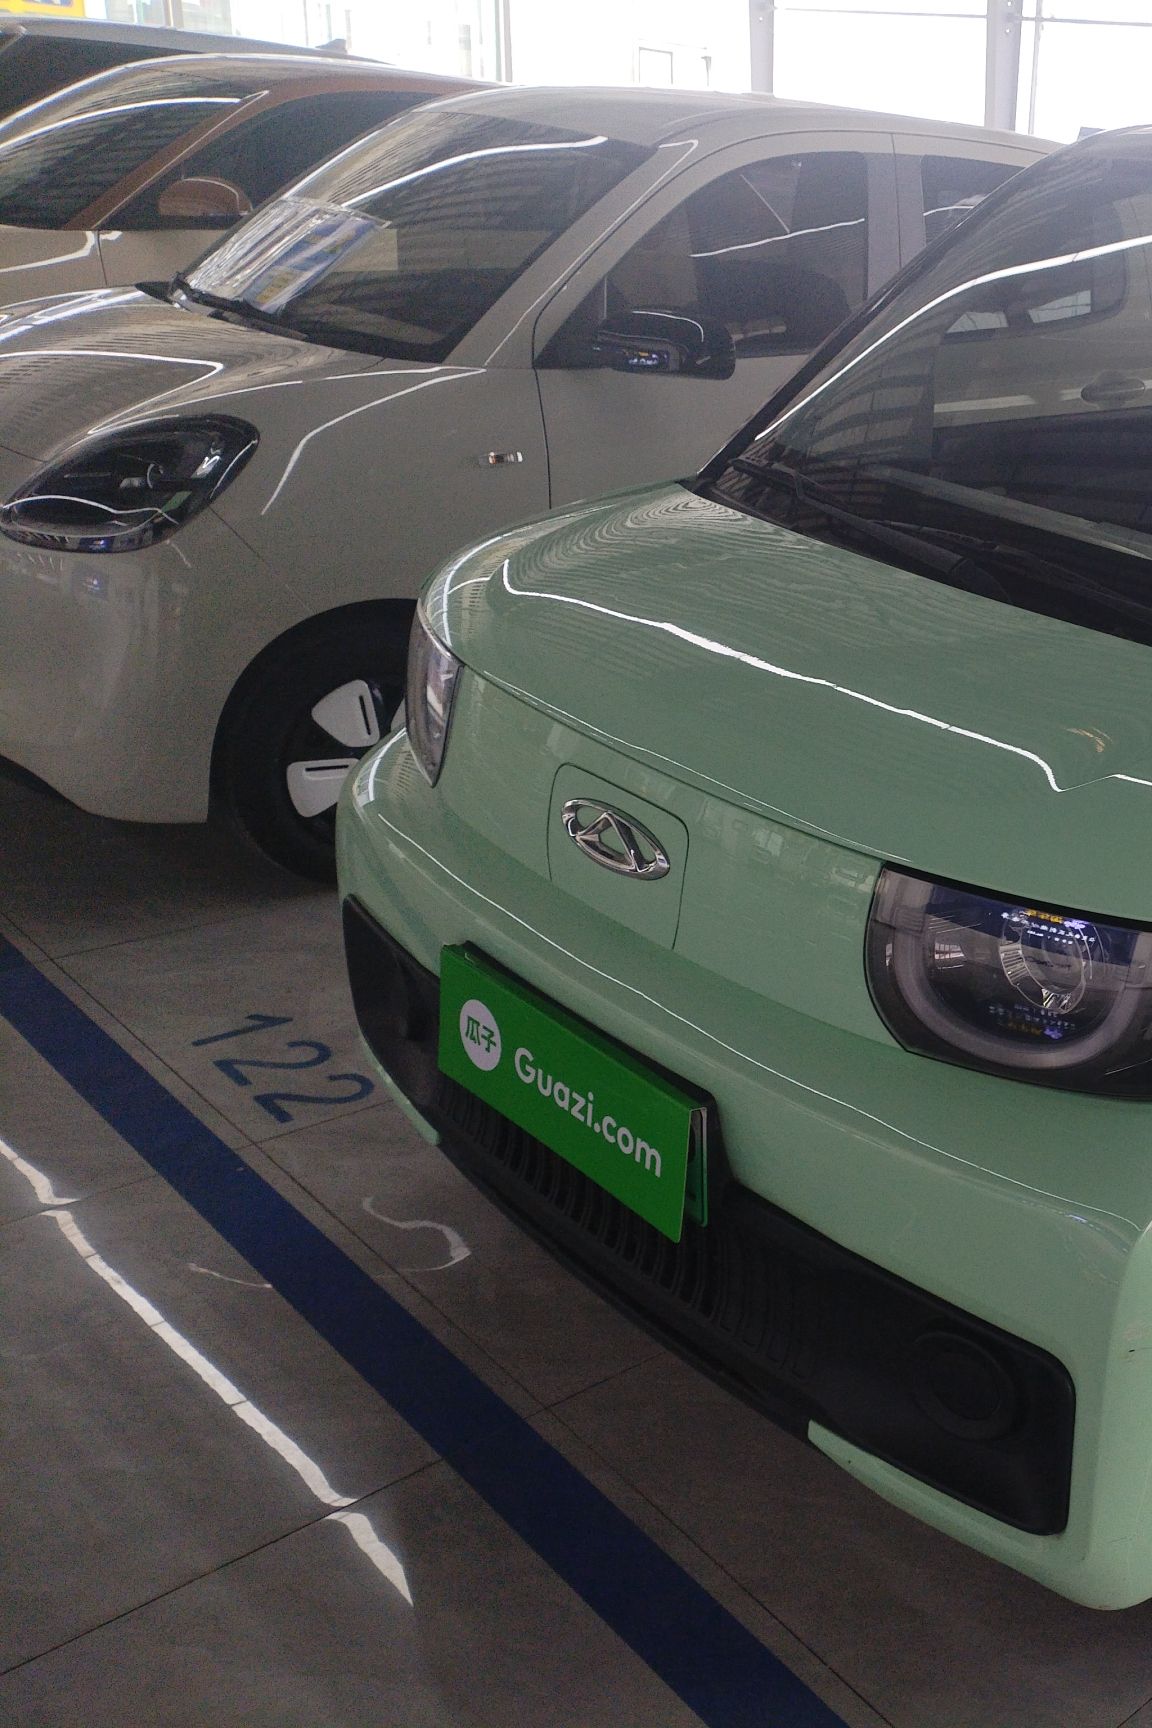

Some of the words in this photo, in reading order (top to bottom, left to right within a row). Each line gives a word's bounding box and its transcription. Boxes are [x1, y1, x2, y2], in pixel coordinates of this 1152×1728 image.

[192, 1014, 374, 1124] 122
[465, 1016, 496, 1053] 瓜子
[514, 1047, 662, 1178] Guazi.com
